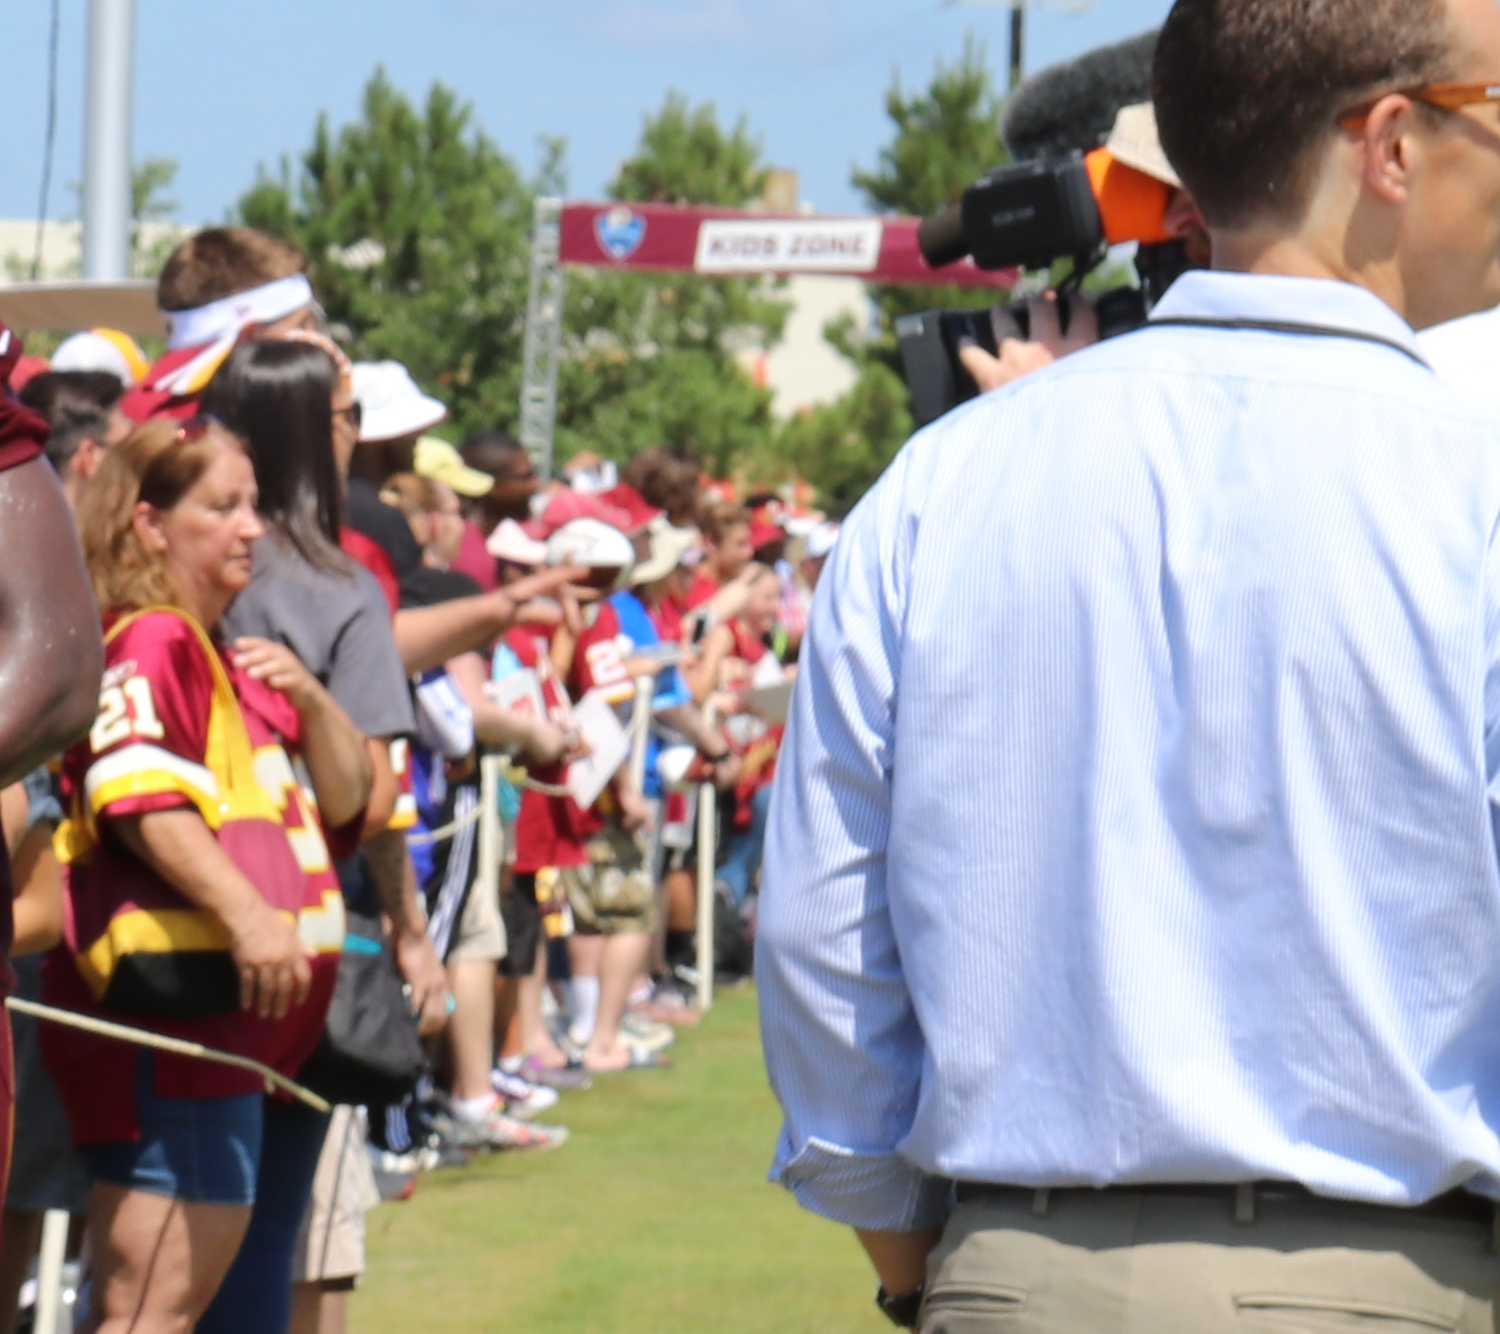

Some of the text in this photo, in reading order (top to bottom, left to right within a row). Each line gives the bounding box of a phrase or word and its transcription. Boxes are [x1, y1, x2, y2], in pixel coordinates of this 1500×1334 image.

[710, 232, 866, 255] KIDS ZONE
[89, 675, 165, 754] 21
